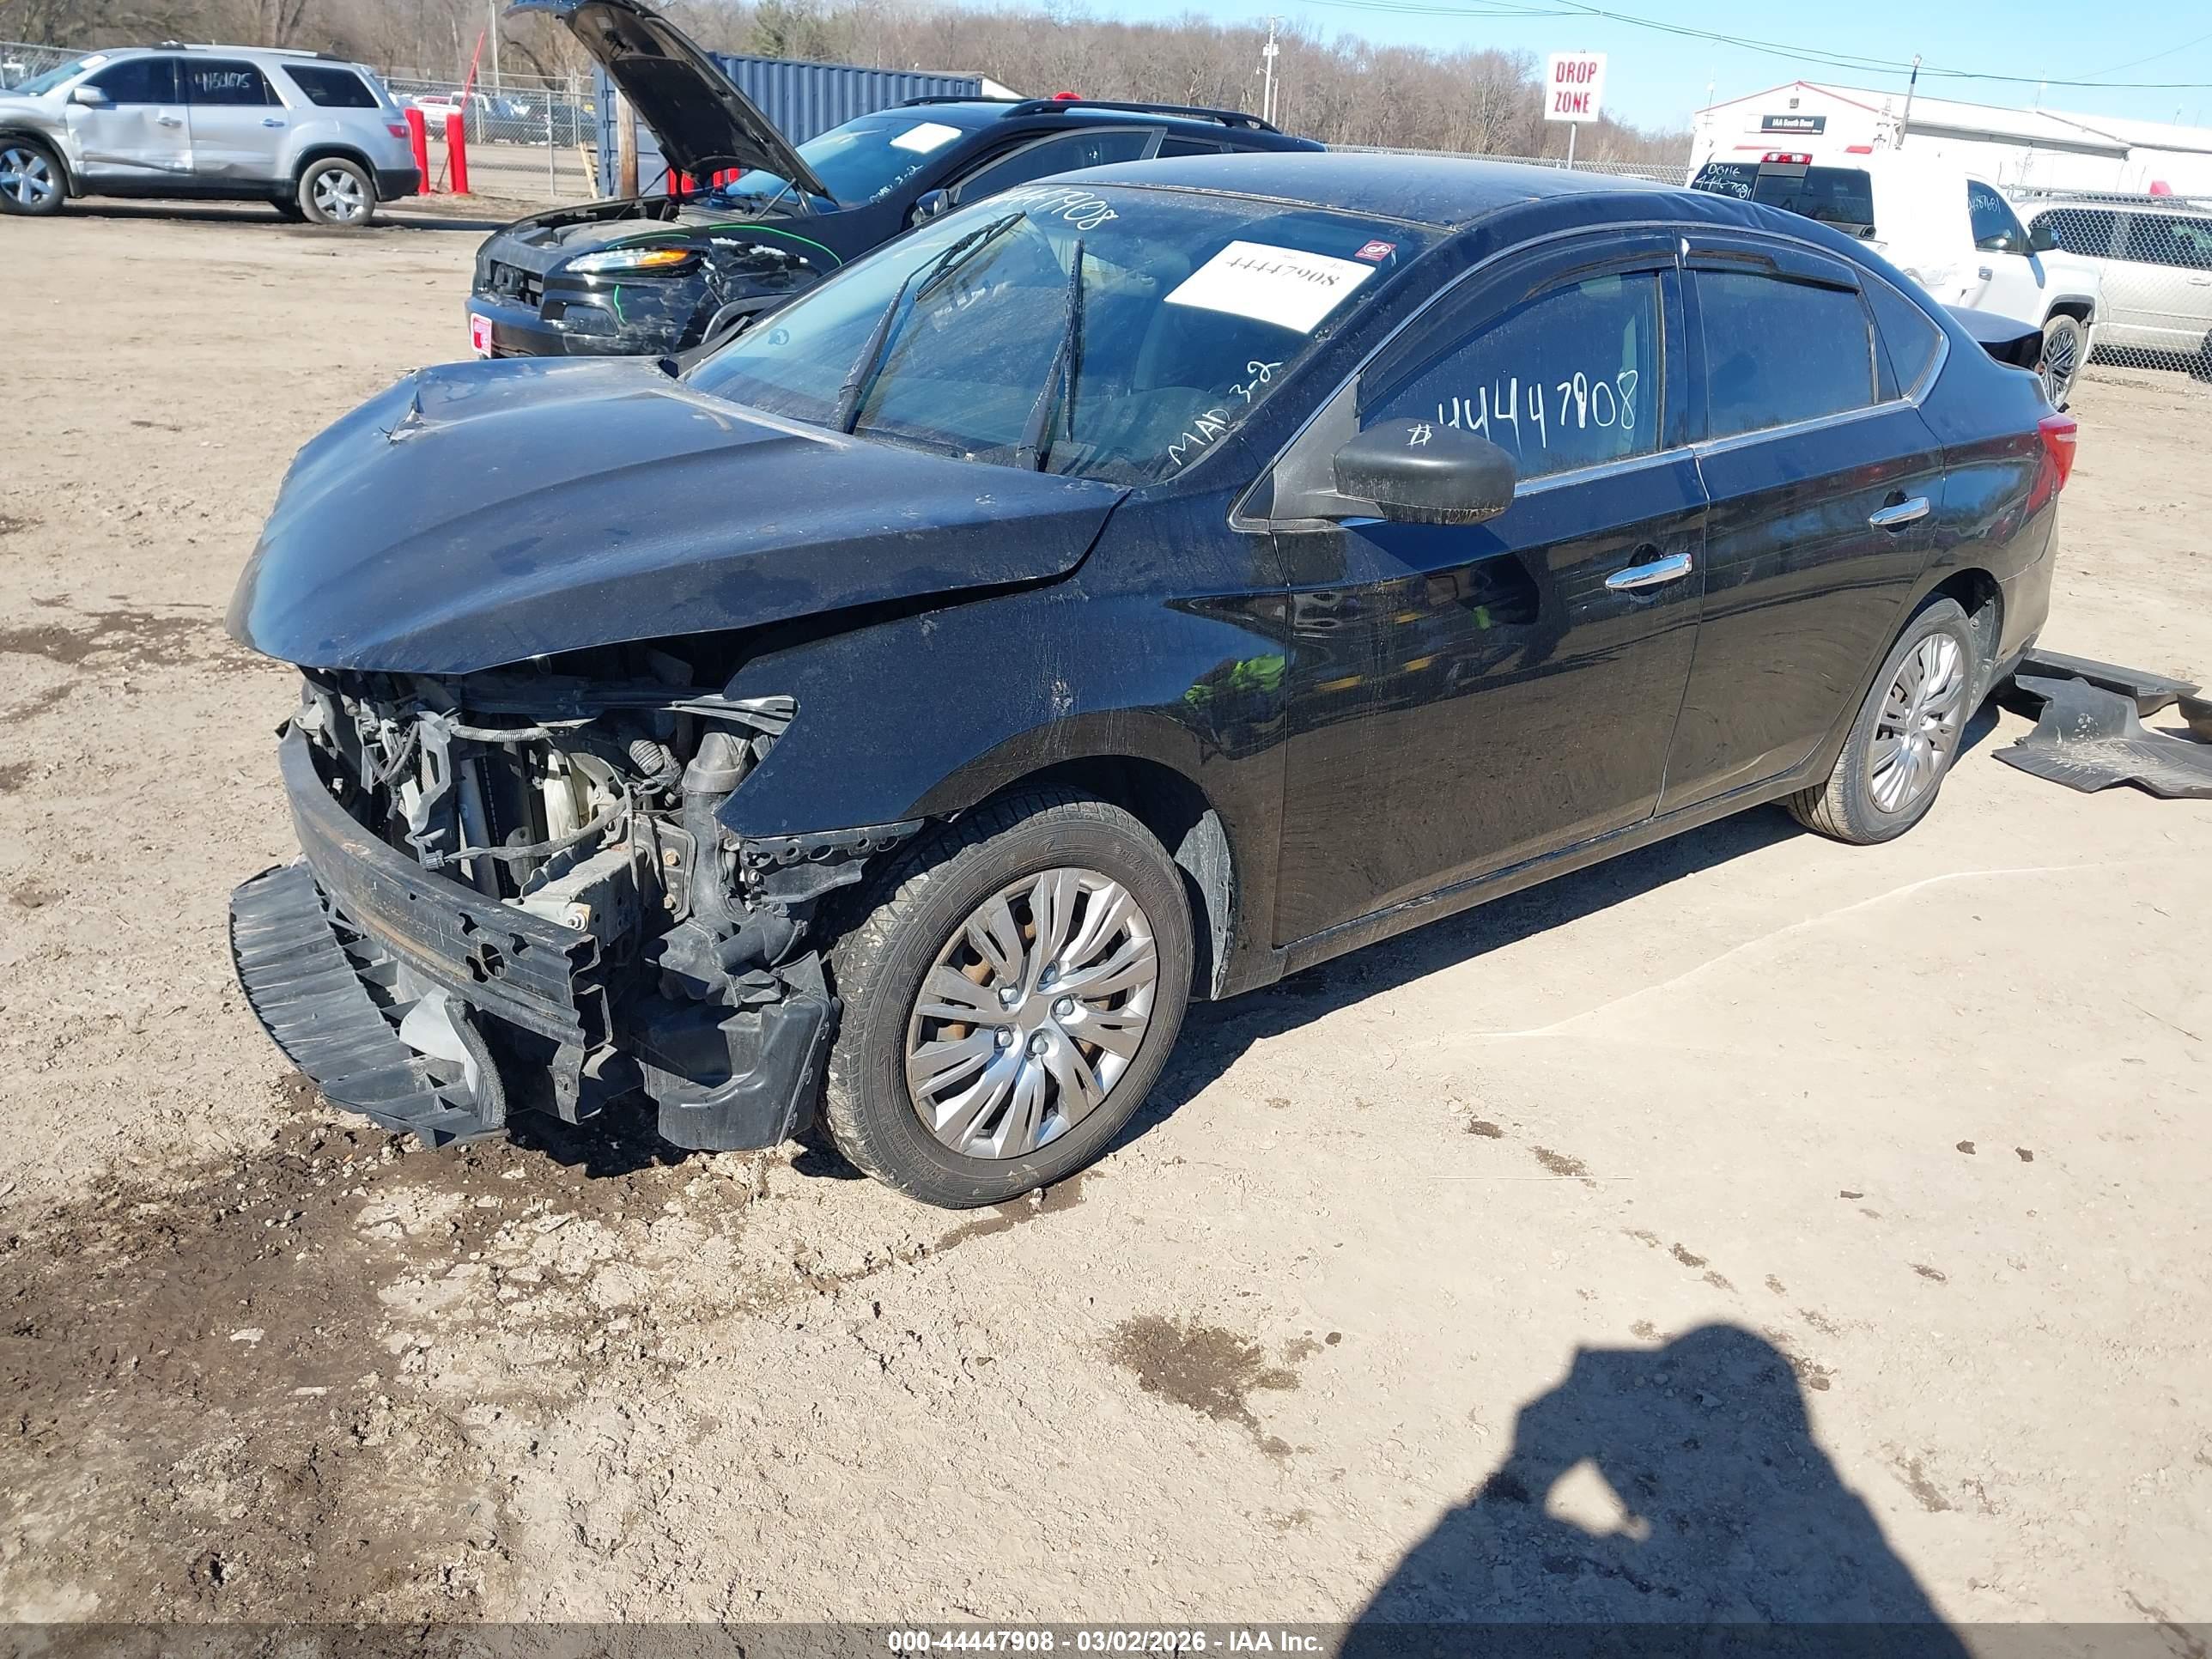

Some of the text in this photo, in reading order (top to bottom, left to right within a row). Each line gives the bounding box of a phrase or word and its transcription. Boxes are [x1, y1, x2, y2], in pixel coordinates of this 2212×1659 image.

[1555, 61, 1597, 83] DROP
[1553, 91, 1590, 114] ZONE
[1226, 257, 1340, 287] 44447908
[1168, 361, 1285, 465] MAD 3-2
